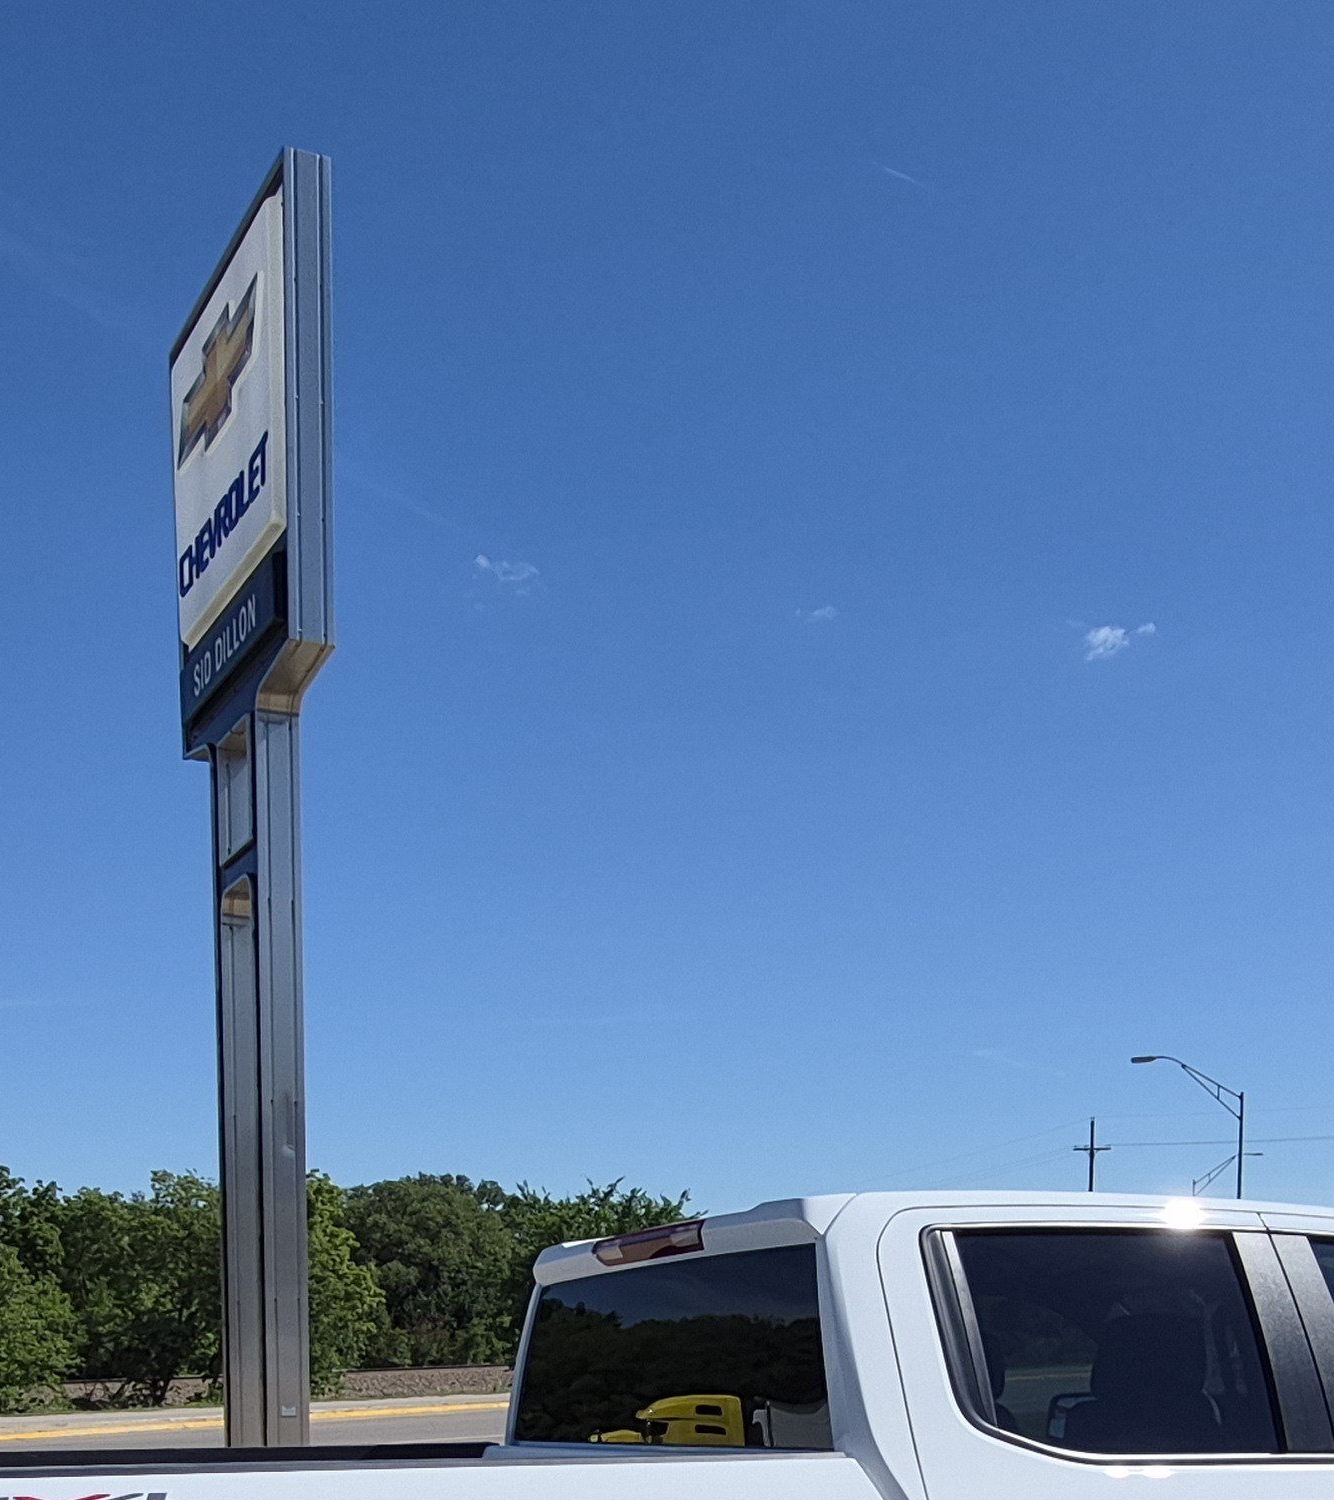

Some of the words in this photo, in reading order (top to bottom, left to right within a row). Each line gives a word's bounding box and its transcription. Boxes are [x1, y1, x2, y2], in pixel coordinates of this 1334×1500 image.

[178, 430, 269, 598] CHEVROLET
[193, 656, 212, 698] SID
[215, 594, 257, 674] DILLON
